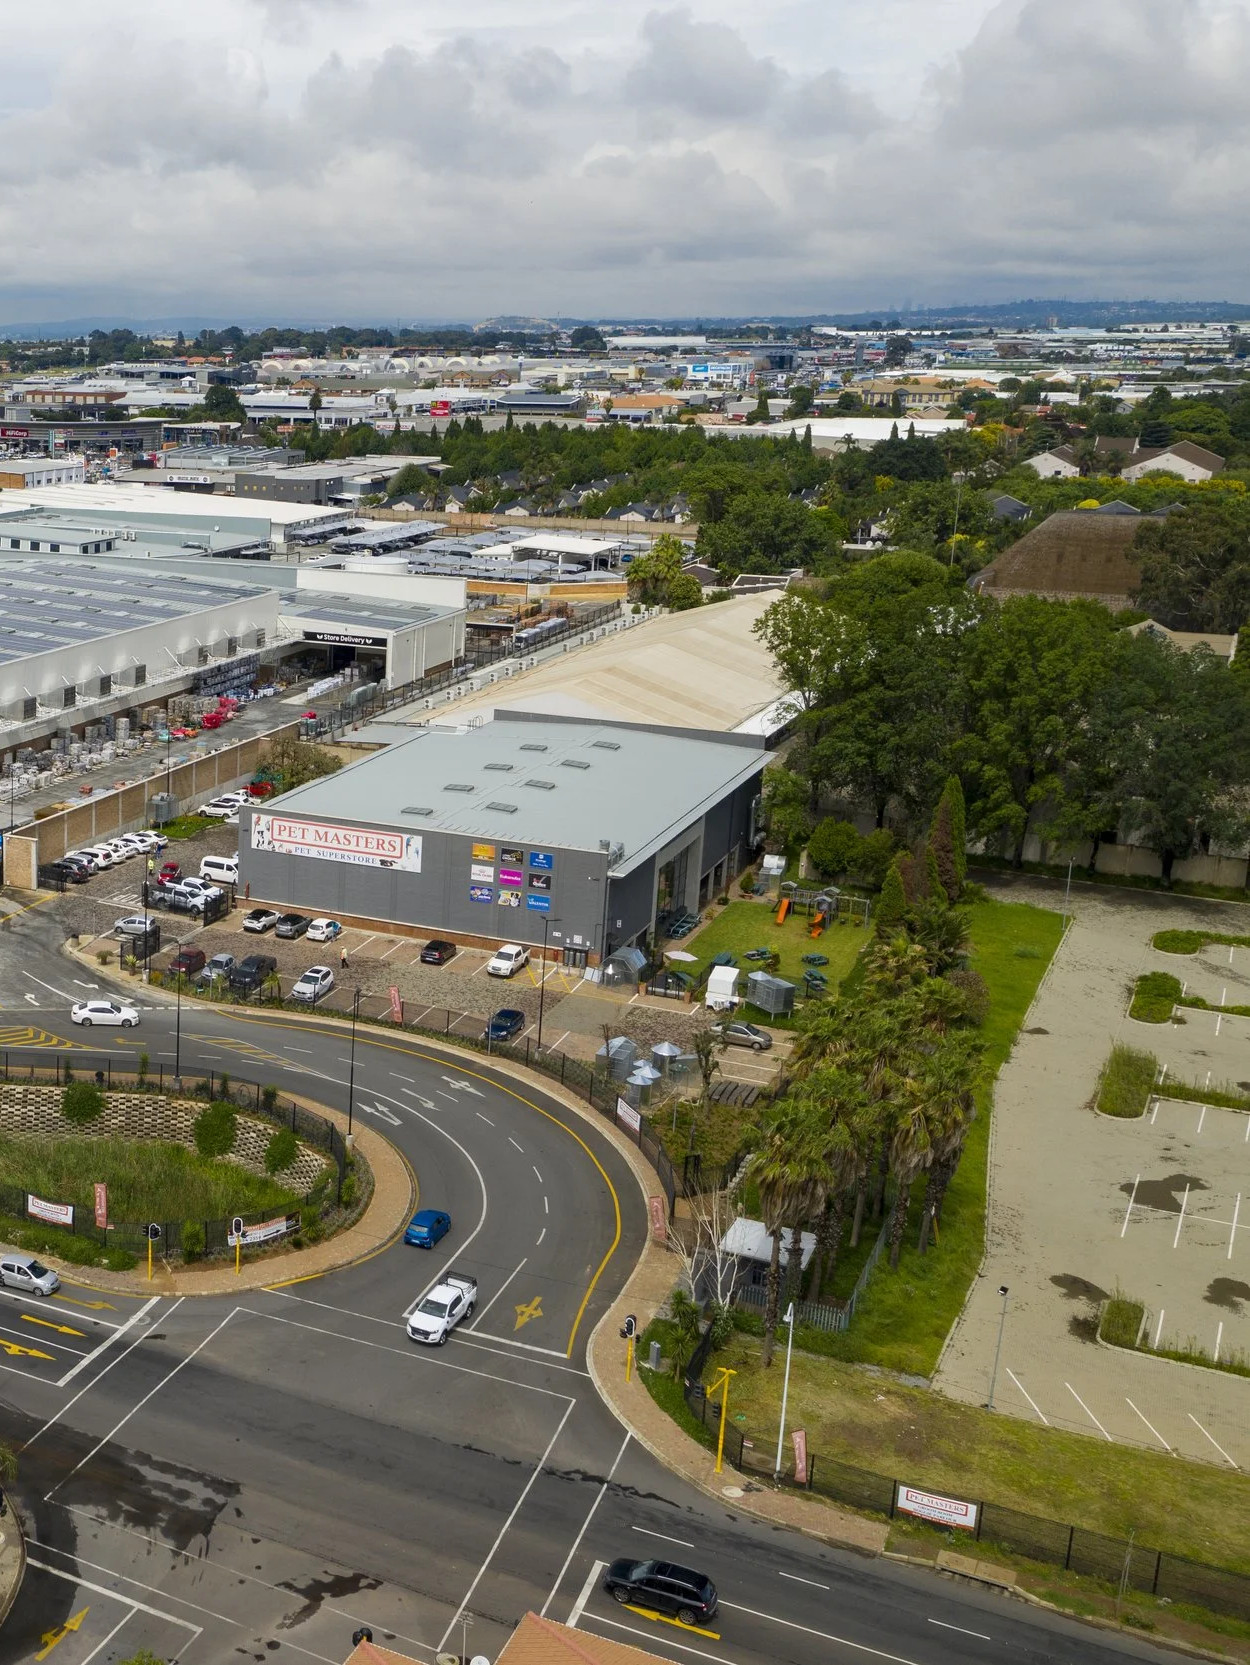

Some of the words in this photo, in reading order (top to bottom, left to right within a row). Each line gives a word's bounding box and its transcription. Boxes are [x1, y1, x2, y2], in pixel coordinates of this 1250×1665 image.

[323, 633, 340, 641] Store
[340, 635, 365, 645] Delivery
[277, 824, 309, 840] PET
[314, 830, 398, 853] MASTERS
[294, 846, 311, 855] PET
[316, 849, 377, 865] SUPERSTORE
[910, 1493, 924, 1502] PET
[925, 1497, 964, 1512] MASTERS
